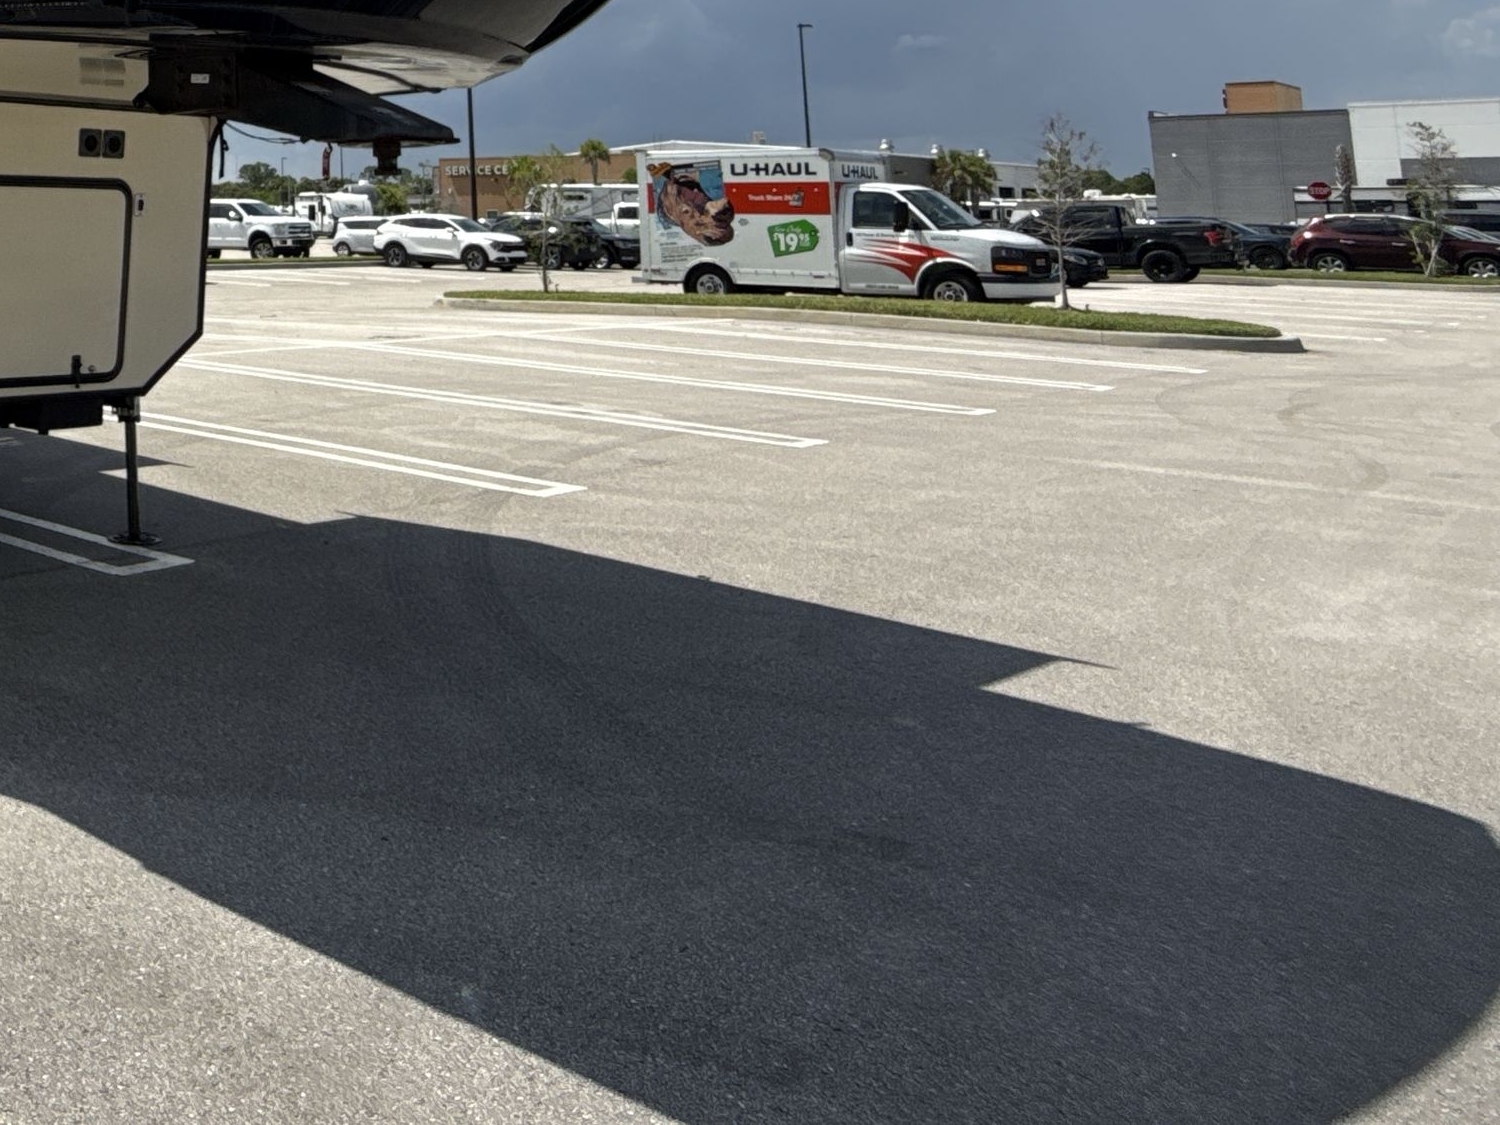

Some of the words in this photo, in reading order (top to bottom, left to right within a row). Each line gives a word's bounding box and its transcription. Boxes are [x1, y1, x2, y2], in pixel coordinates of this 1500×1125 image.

[445, 165, 492, 176] SERVCE
[730, 162, 817, 176] U-HAUL
[1309, 186, 1330, 195] STOP
